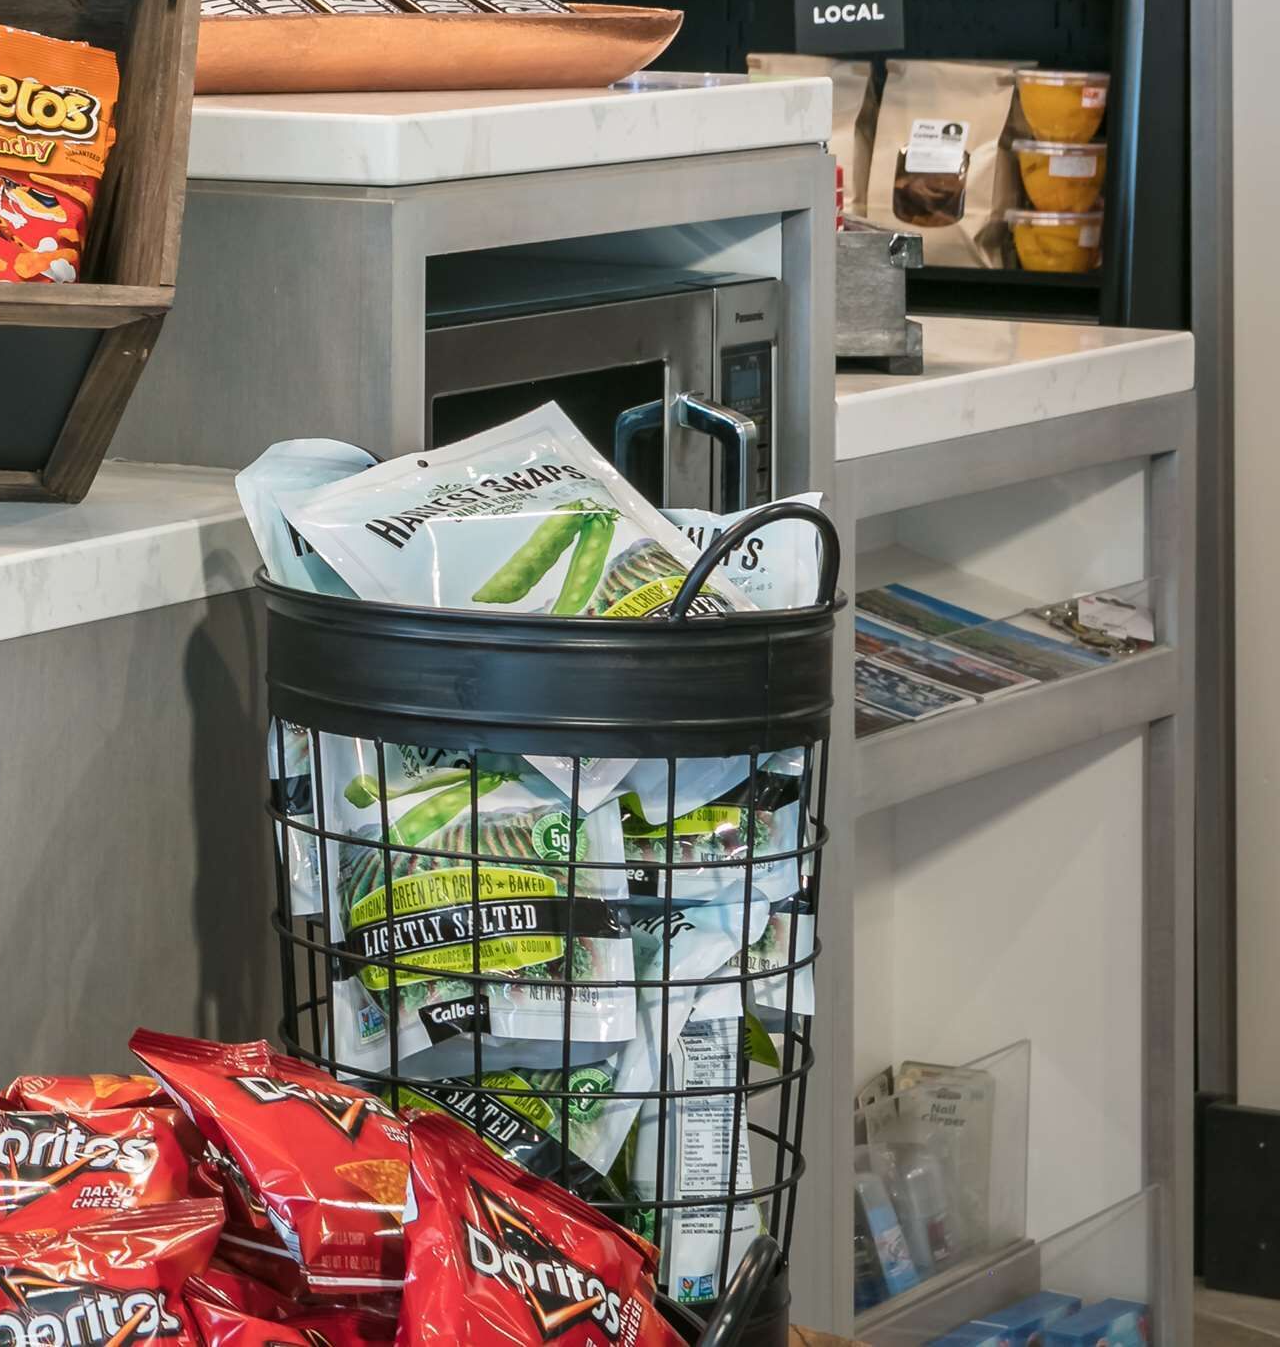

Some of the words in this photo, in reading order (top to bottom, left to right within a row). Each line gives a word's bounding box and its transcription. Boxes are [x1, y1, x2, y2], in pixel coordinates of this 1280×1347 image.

[813, 2, 886, 25] LOCAL
[734, 311, 765, 325] Panasonic
[365, 485, 483, 549] HARVEST
[479, 463, 588, 494] SNAPS
[696, 808, 729, 822] SODIUM
[551, 829, 571, 853] 5g
[355, 897, 388, 921] ORIGINA
[392, 883, 427, 910] GREEN
[428, 878, 449, 903] PEA
[452, 873, 494, 900] CRIPS
[508, 877, 546, 893] BAKED
[363, 911, 445, 958] LIGHTLY
[431, 949, 461, 964] SOURCE
[501, 942, 518, 955] LOW
[520, 939, 552, 954] SODIUM
[930, 1103, 957, 1114] Nail
[71, 1195, 132, 1211] CHEESE
[78, 1183, 139, 1201] NACHO
[466, 1220, 622, 1336] Doritos
